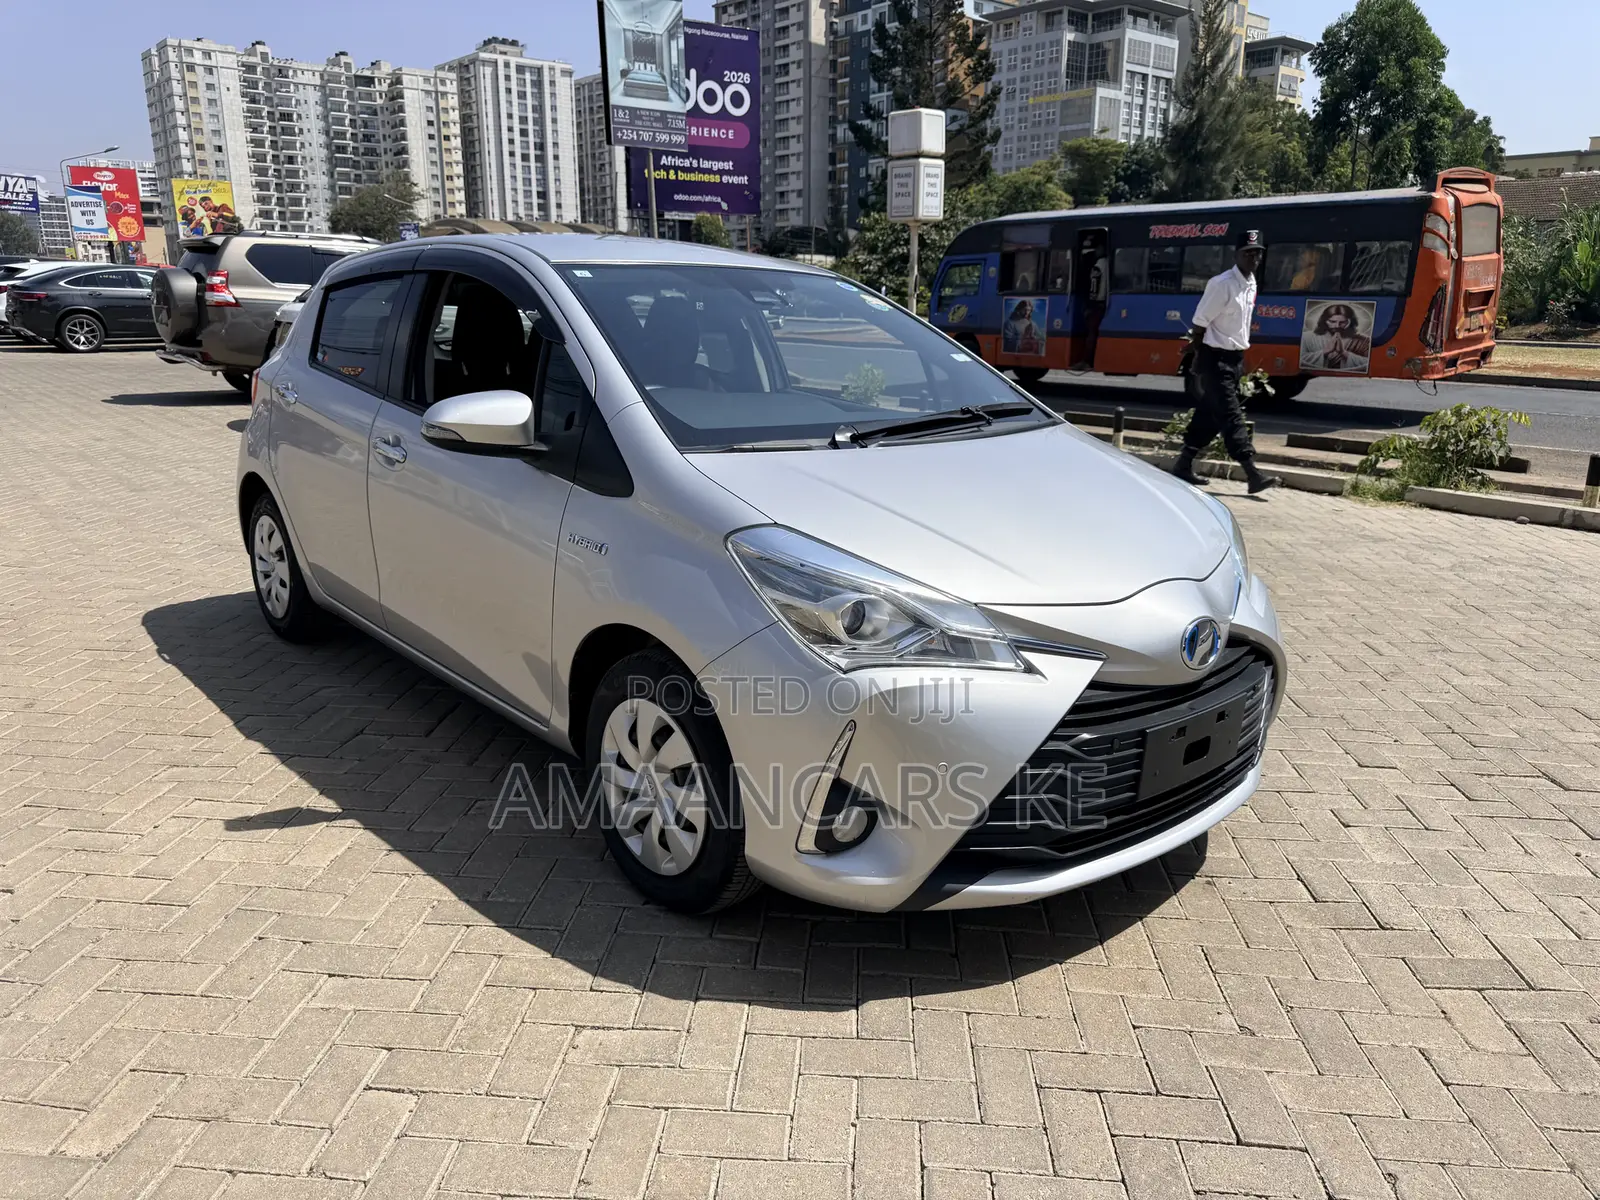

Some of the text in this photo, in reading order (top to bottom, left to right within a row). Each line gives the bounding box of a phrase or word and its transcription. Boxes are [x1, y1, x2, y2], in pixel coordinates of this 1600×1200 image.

[731, 33, 749, 41] Nairobi
[723, 70, 751, 84] 2026
[613, 108, 630, 119] 1&2
[616, 129, 686, 145] +254 707 599 999
[660, 154, 734, 171] Africa's largest
[668, 169, 677, 180] &
[678, 170, 720, 183] business
[722, 174, 749, 185] event
[70, 200, 103, 208] ADVERTISE
[673, 193, 722, 203] odoo.com/africa
[1201, 222, 1230, 238] SON
[567, 532, 601, 553] HYBRID
